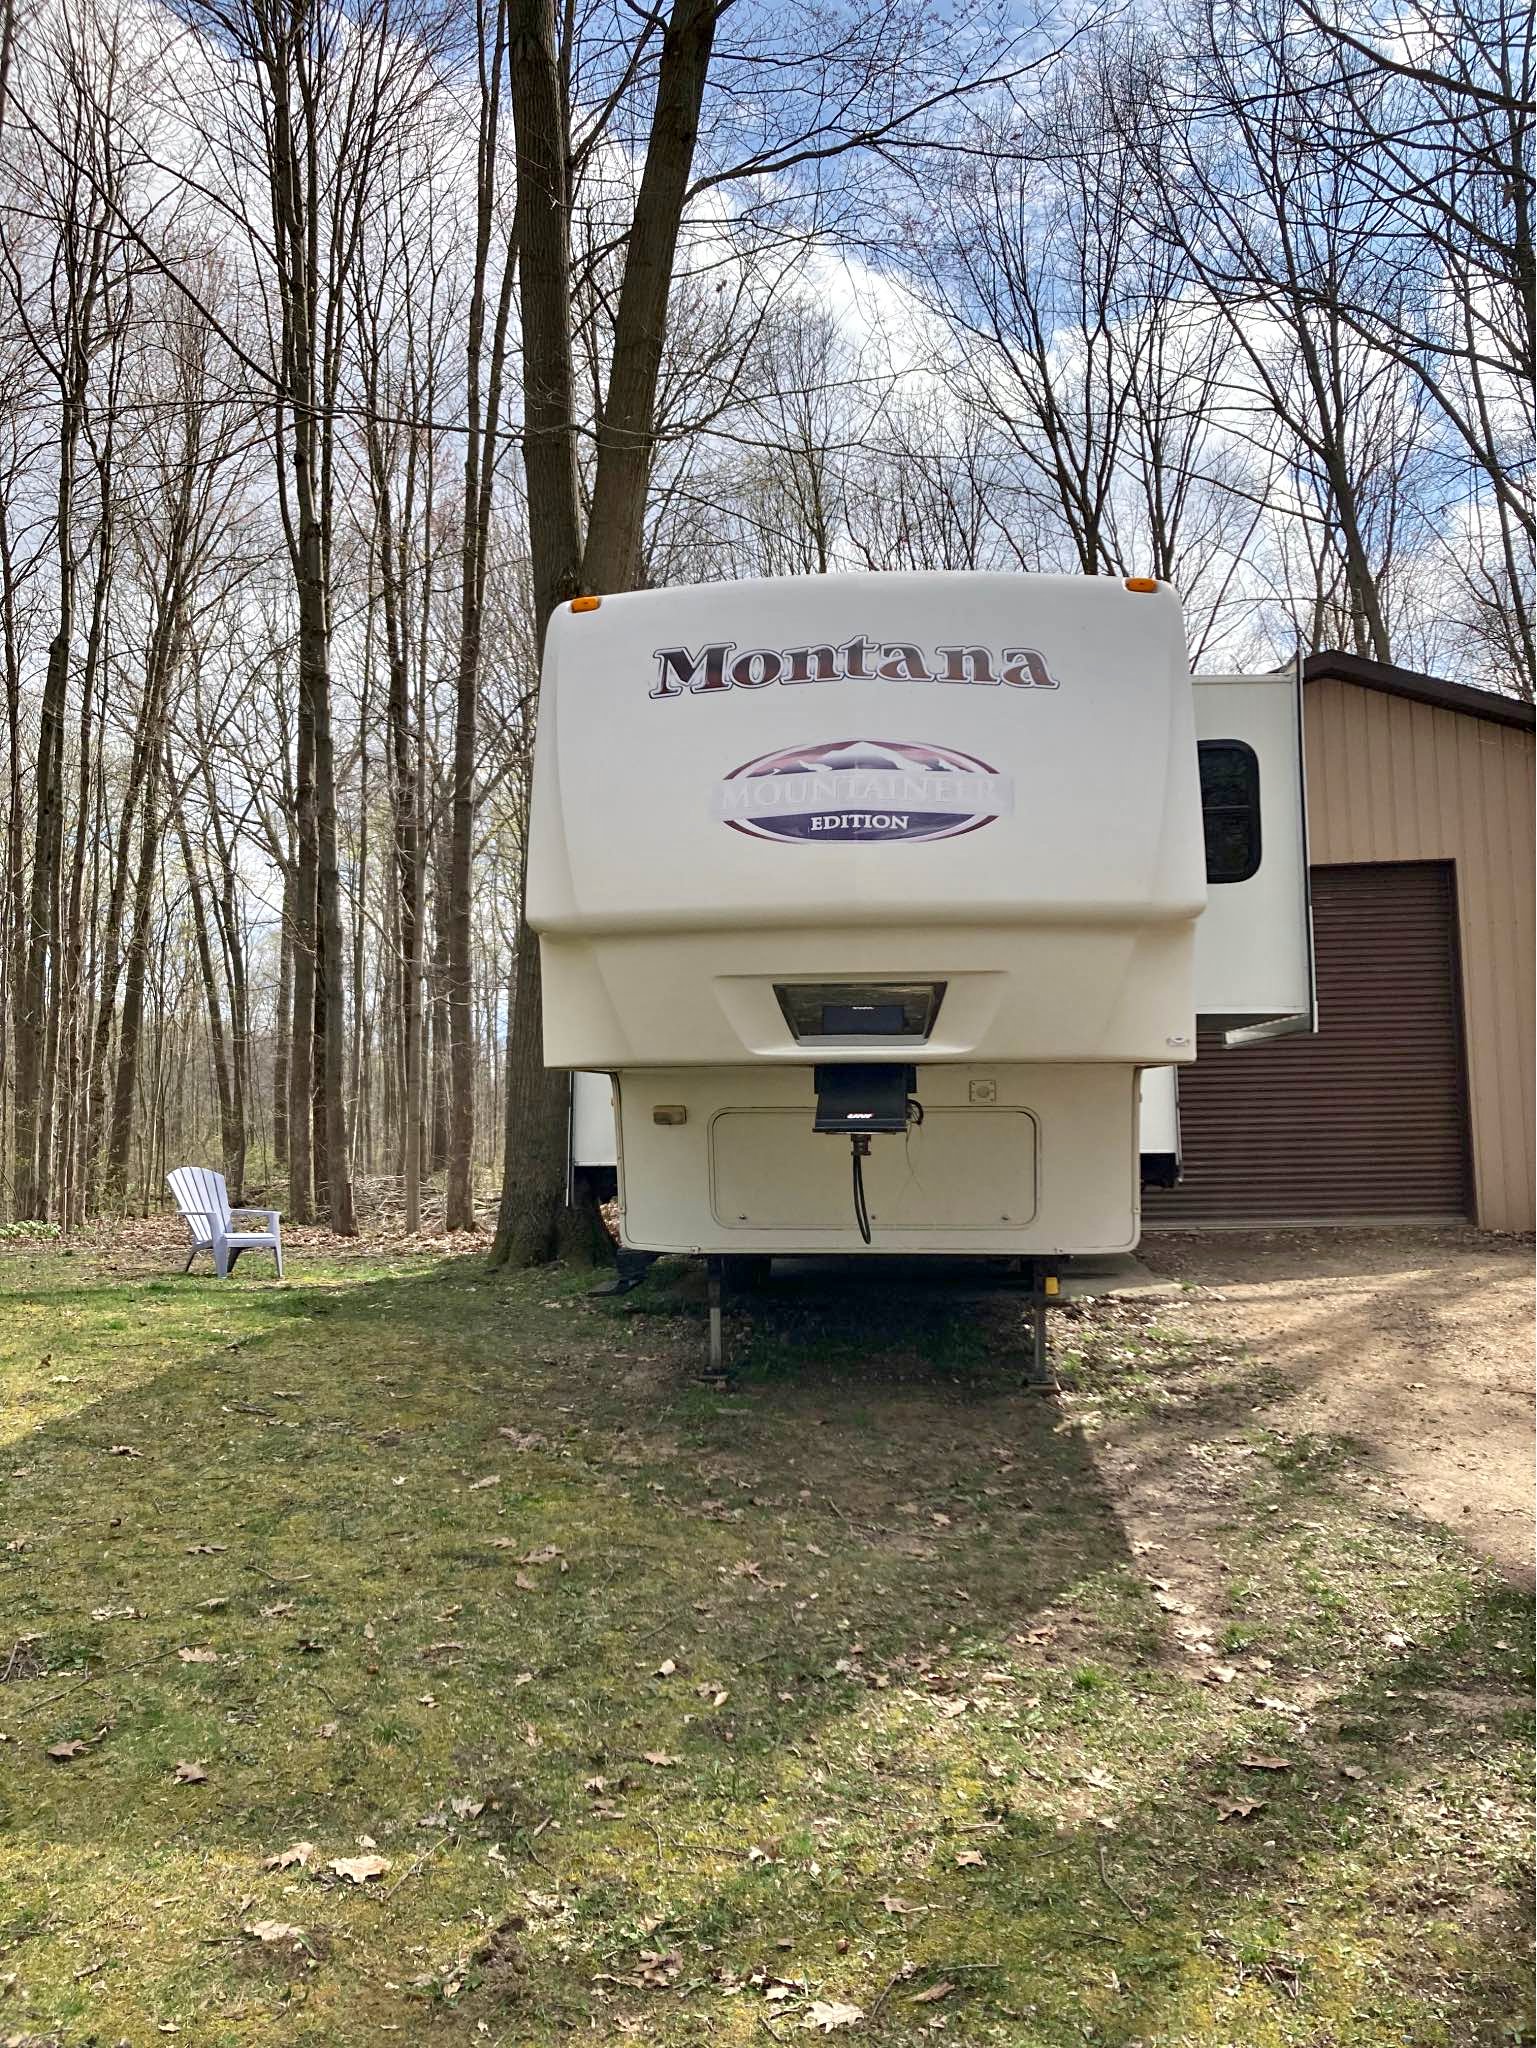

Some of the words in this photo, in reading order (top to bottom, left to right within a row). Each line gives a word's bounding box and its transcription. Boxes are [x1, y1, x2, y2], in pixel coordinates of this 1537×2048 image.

[649, 635, 1060, 698] Montana
[721, 774, 1000, 810] MOUNTAINEER
[810, 814, 910, 832] EDITION
